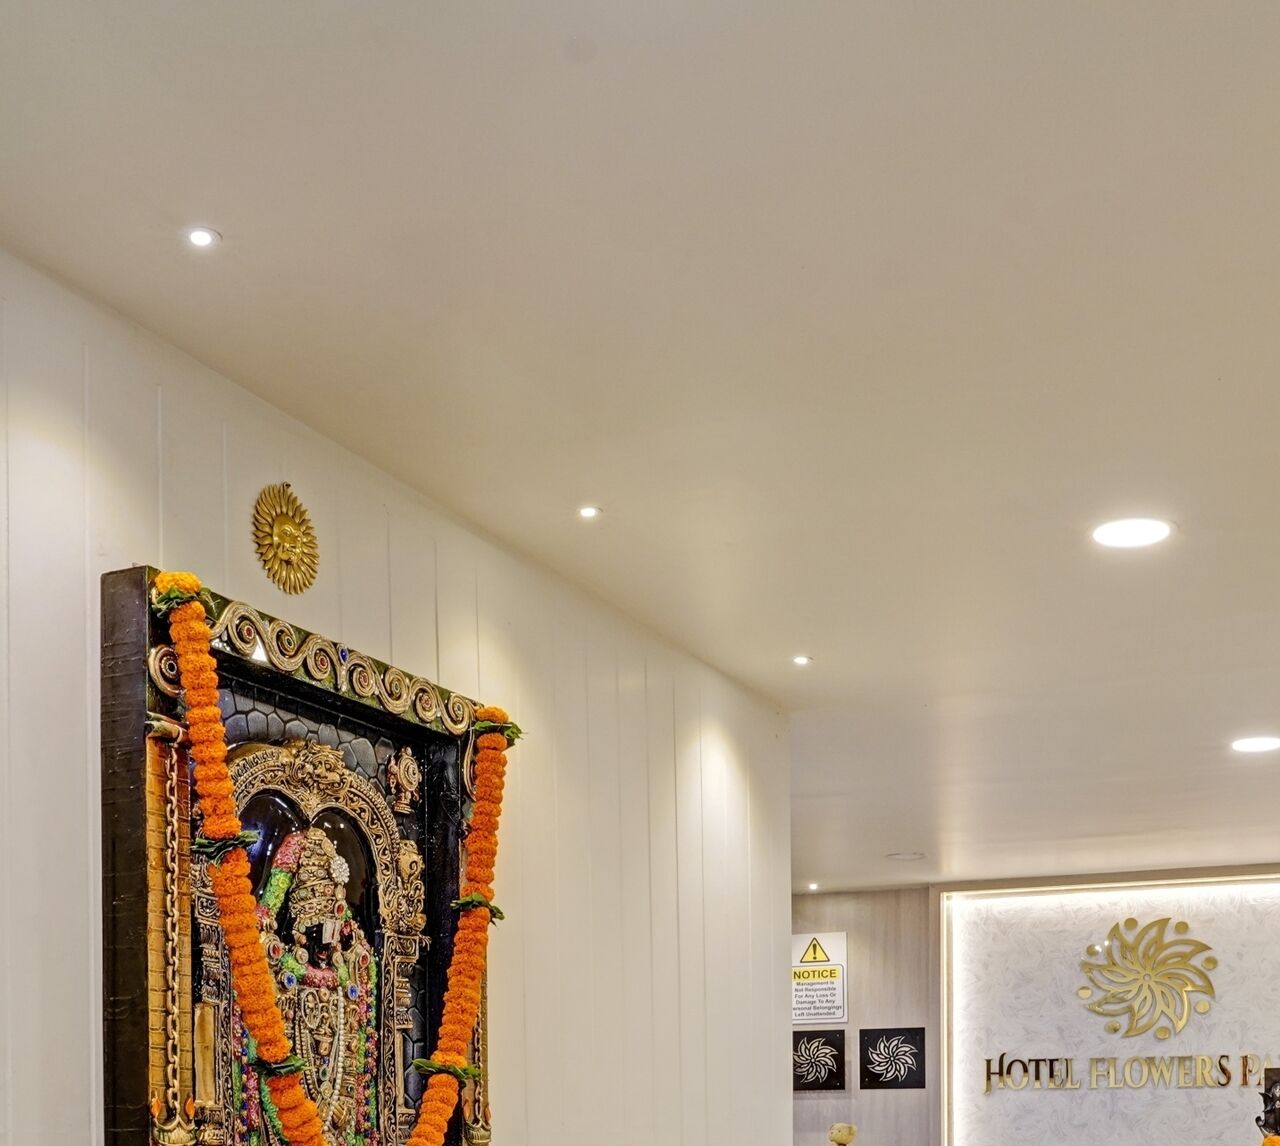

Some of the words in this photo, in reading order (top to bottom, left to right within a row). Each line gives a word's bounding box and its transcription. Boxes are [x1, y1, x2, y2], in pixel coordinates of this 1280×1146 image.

[793, 969, 837, 980] NOTICE
[984, 1052, 1080, 1095] HOTEL
[1089, 1055, 1231, 1090] FLOWERS
